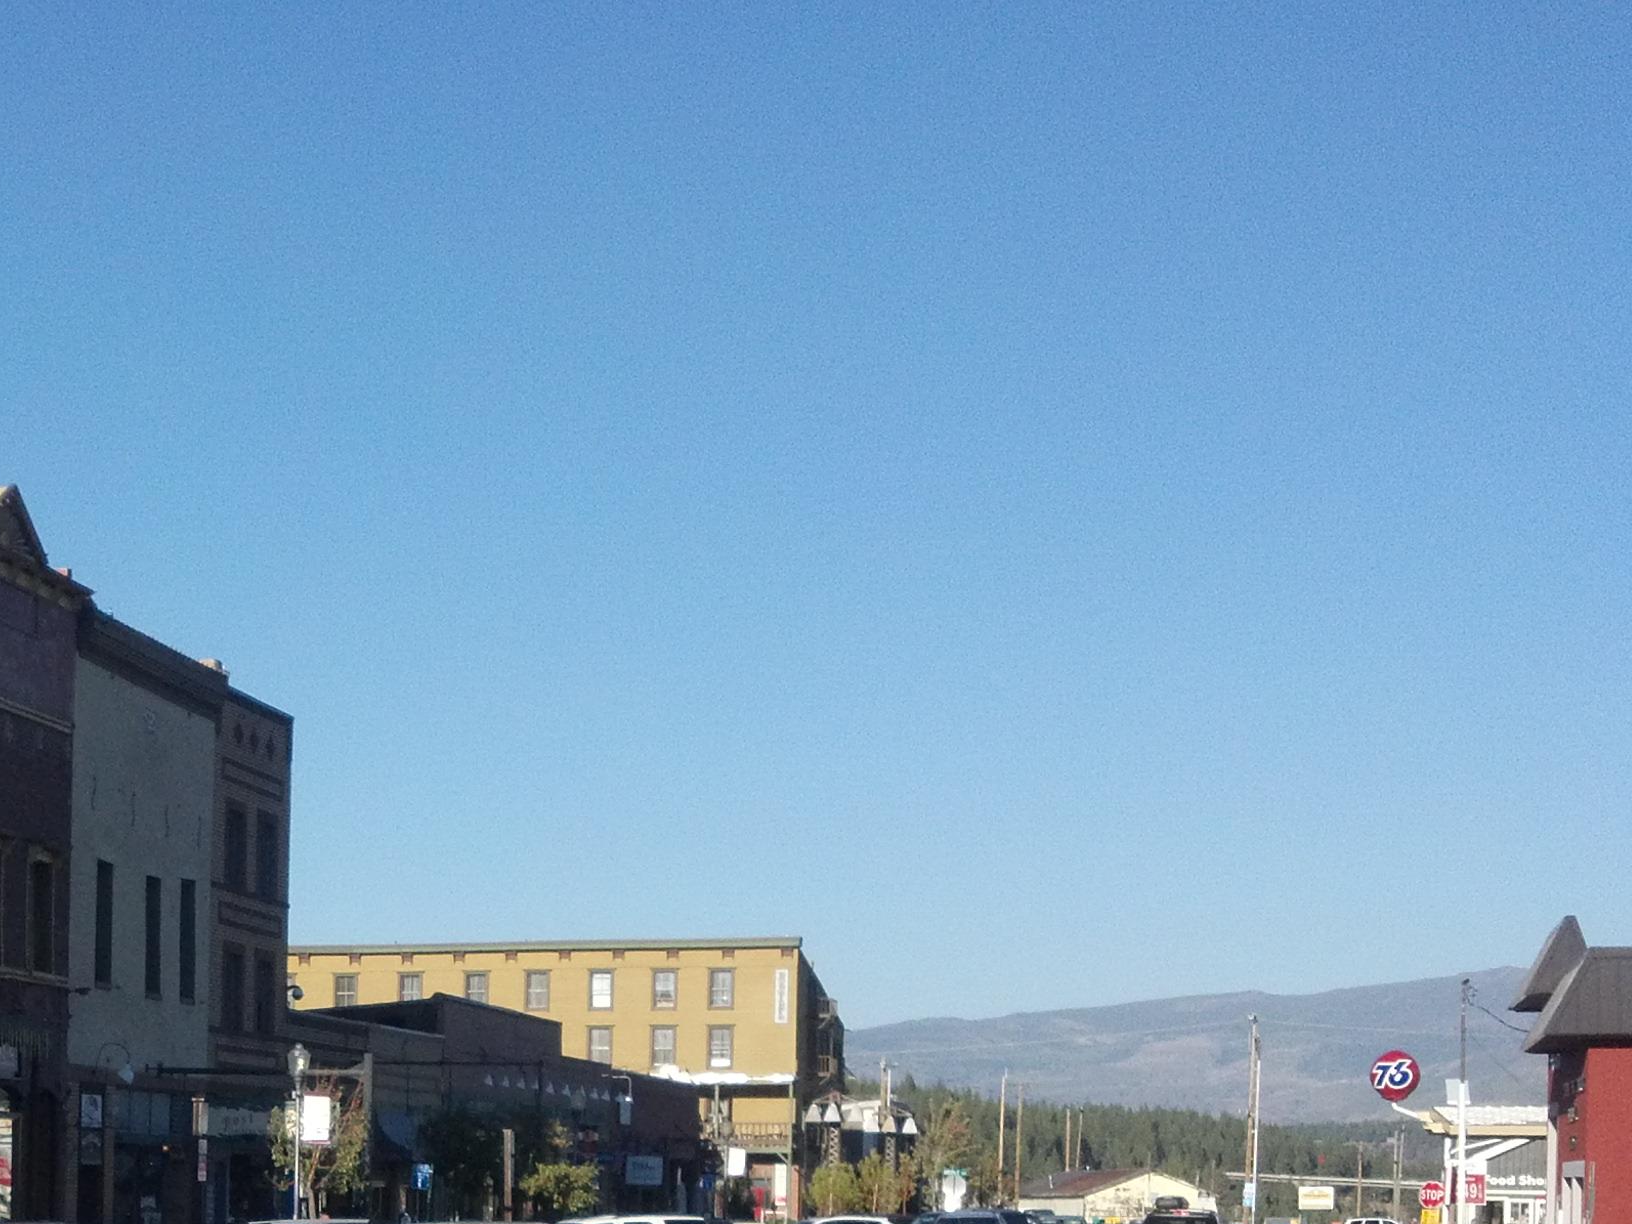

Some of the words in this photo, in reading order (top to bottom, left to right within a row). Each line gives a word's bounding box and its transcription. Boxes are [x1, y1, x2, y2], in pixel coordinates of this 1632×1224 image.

[1372, 1058, 1413, 1089] 76
[1518, 1174, 1546, 1187] Sho
[1420, 1189, 1445, 1201] STOP
